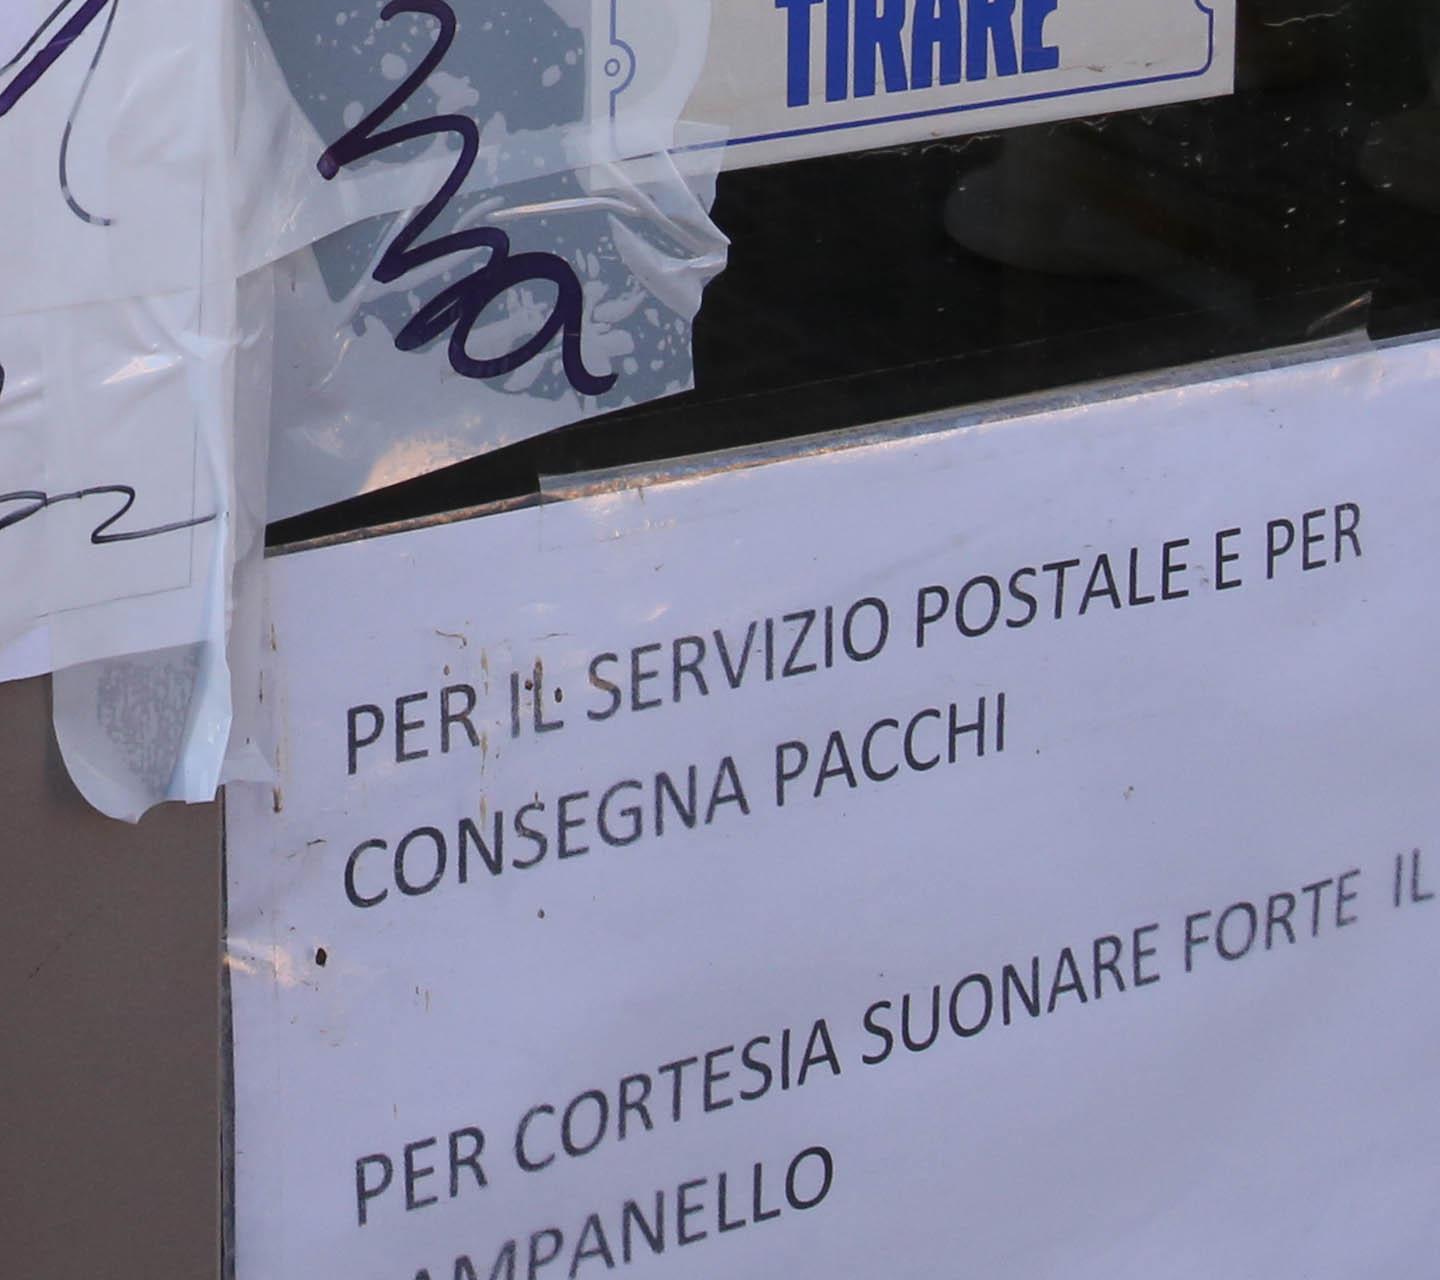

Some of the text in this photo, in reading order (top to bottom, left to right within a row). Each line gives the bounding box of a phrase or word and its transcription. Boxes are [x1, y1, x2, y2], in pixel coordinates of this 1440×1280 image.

[346, 501, 1363, 776] PER IL SERVIZIO POSTALE E PER
[343, 692, 1006, 909] CONSEGNA PACCHI
[354, 847, 1435, 1228] PER CORTESIA SUONARE FORTE IL
[410, 1145, 834, 1280] PANELLO
